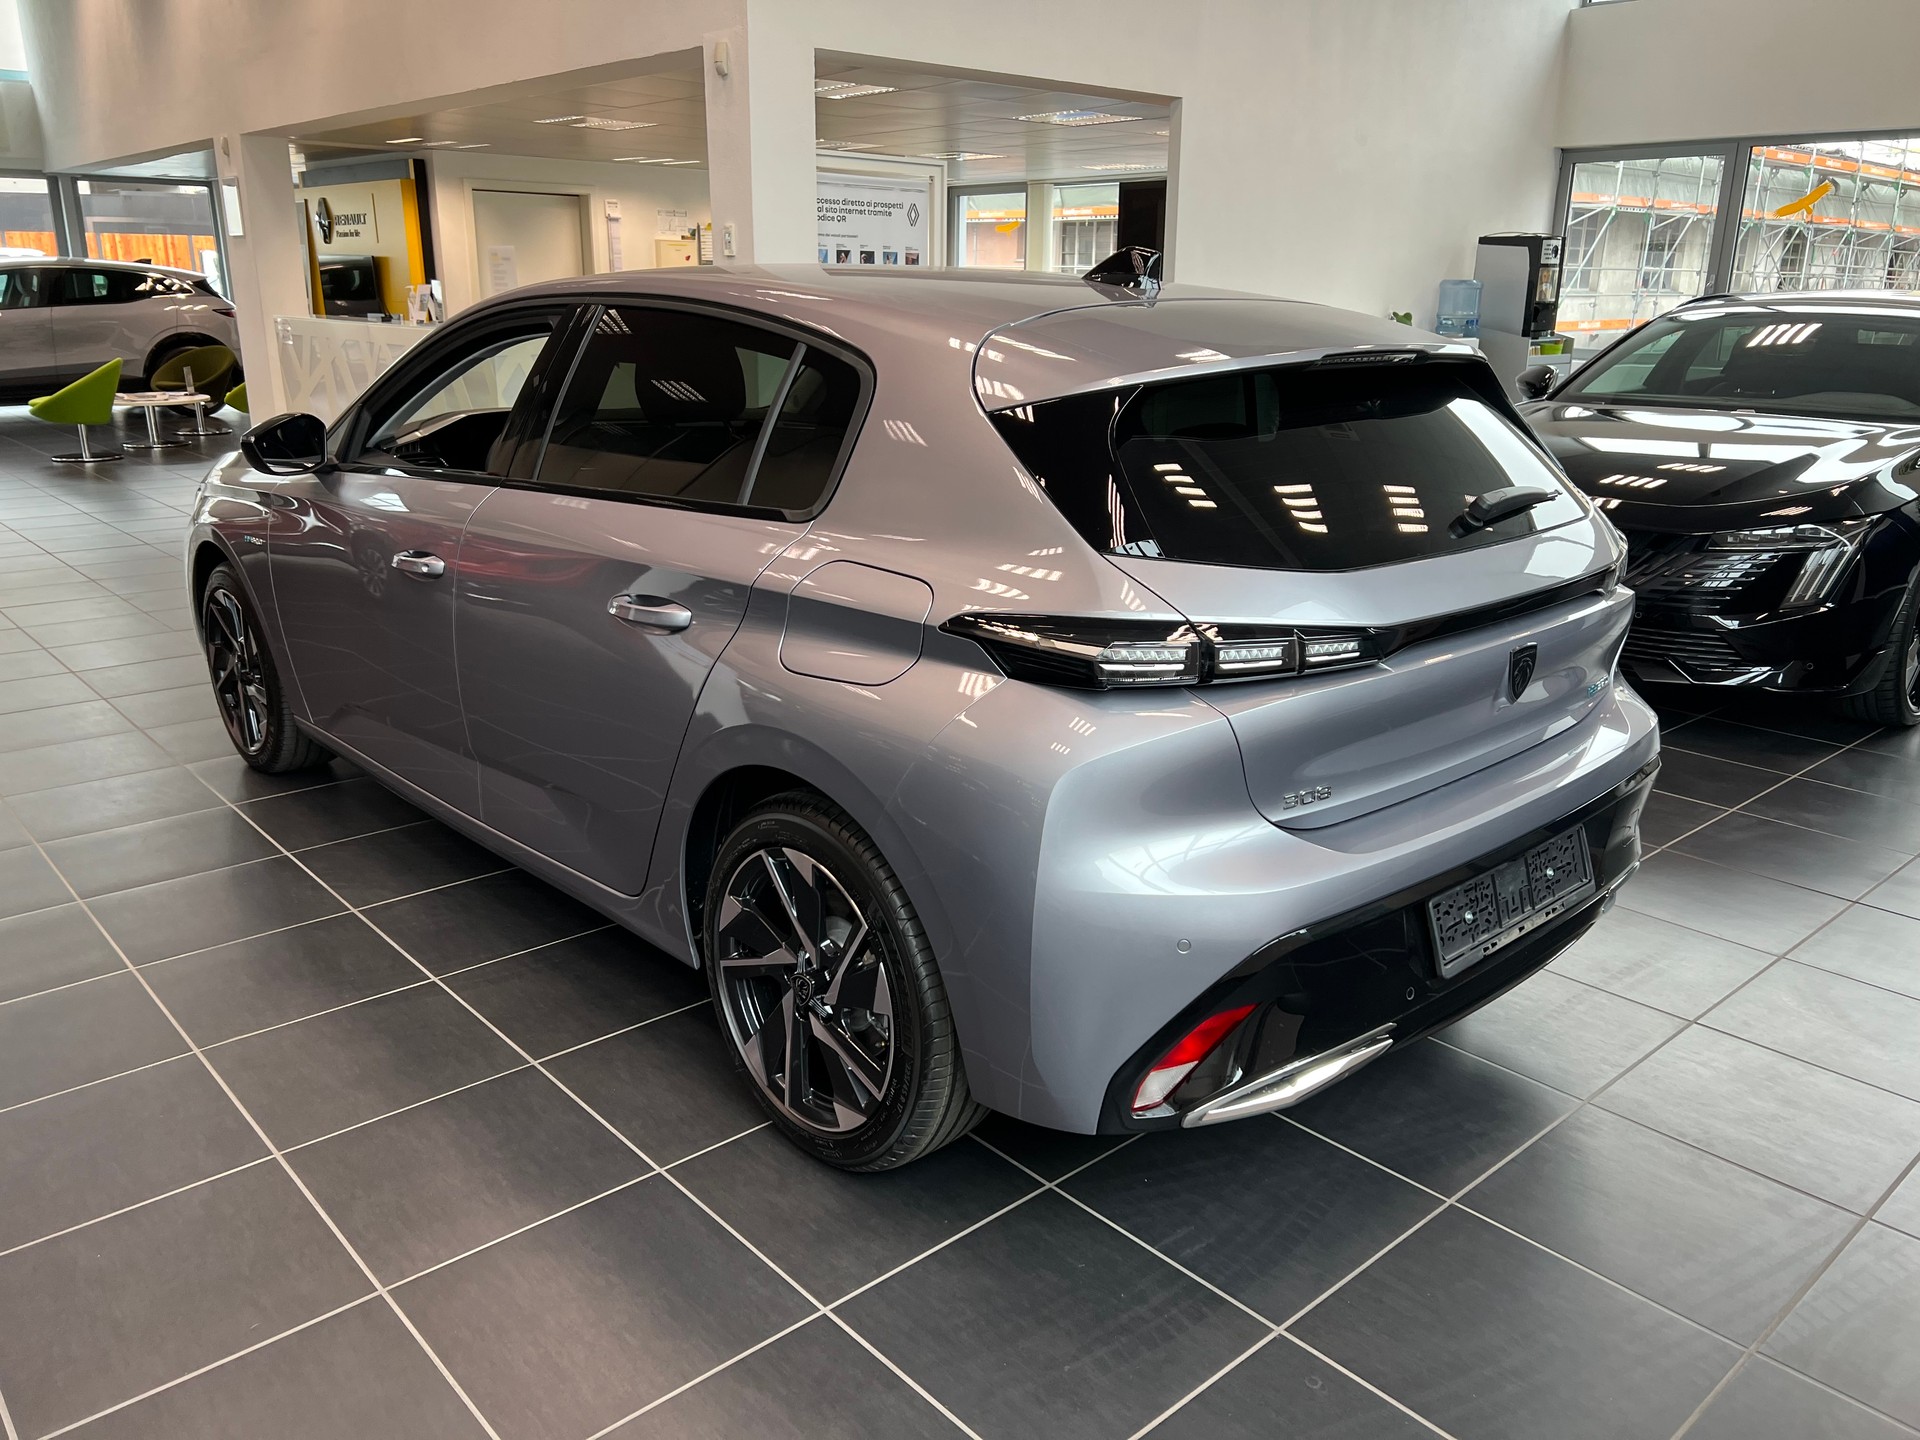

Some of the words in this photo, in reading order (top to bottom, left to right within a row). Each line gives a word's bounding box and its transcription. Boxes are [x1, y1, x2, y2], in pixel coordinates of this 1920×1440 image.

[841, 198, 865, 207] diretto
[866, 200, 872, 208] ai
[873, 200, 904, 210] prospetti
[825, 206, 838, 214] sito
[838, 206, 866, 216] internet
[867, 209, 892, 217] tramite
[335, 213, 366, 226] RENAULT
[836, 215, 847, 223] QR
[1283, 785, 1331, 810] 308
